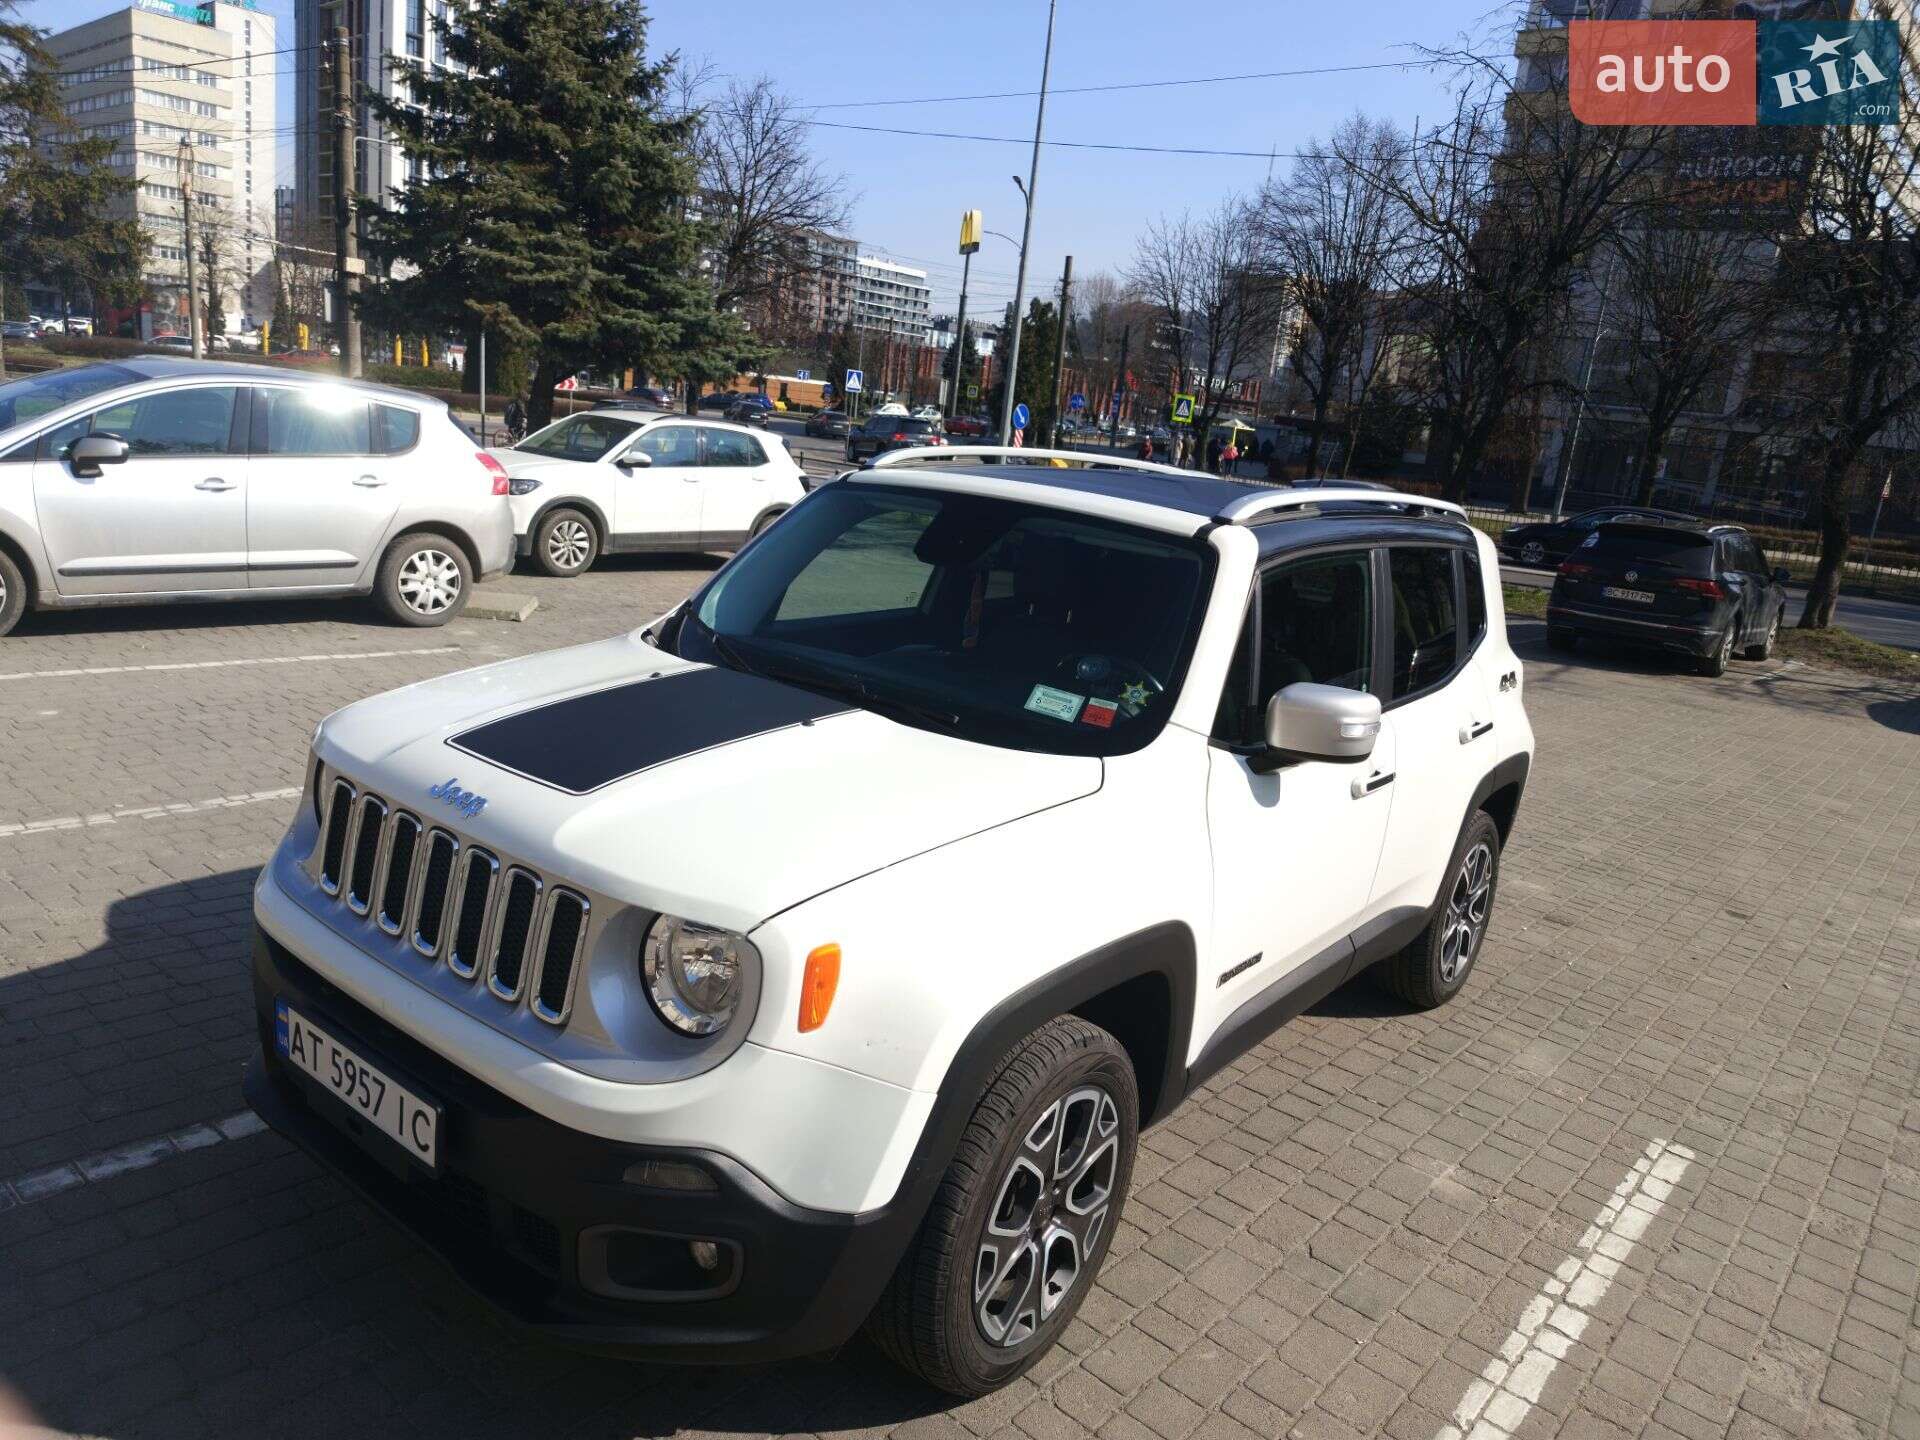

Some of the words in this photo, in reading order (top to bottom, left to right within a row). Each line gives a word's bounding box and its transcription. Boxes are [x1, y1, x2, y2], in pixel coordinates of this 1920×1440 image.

[431, 778, 487, 818] Jeep
[292, 1022, 323, 1071] AT
[331, 1047, 386, 1116] 5957
[399, 1096, 430, 1152] IC
